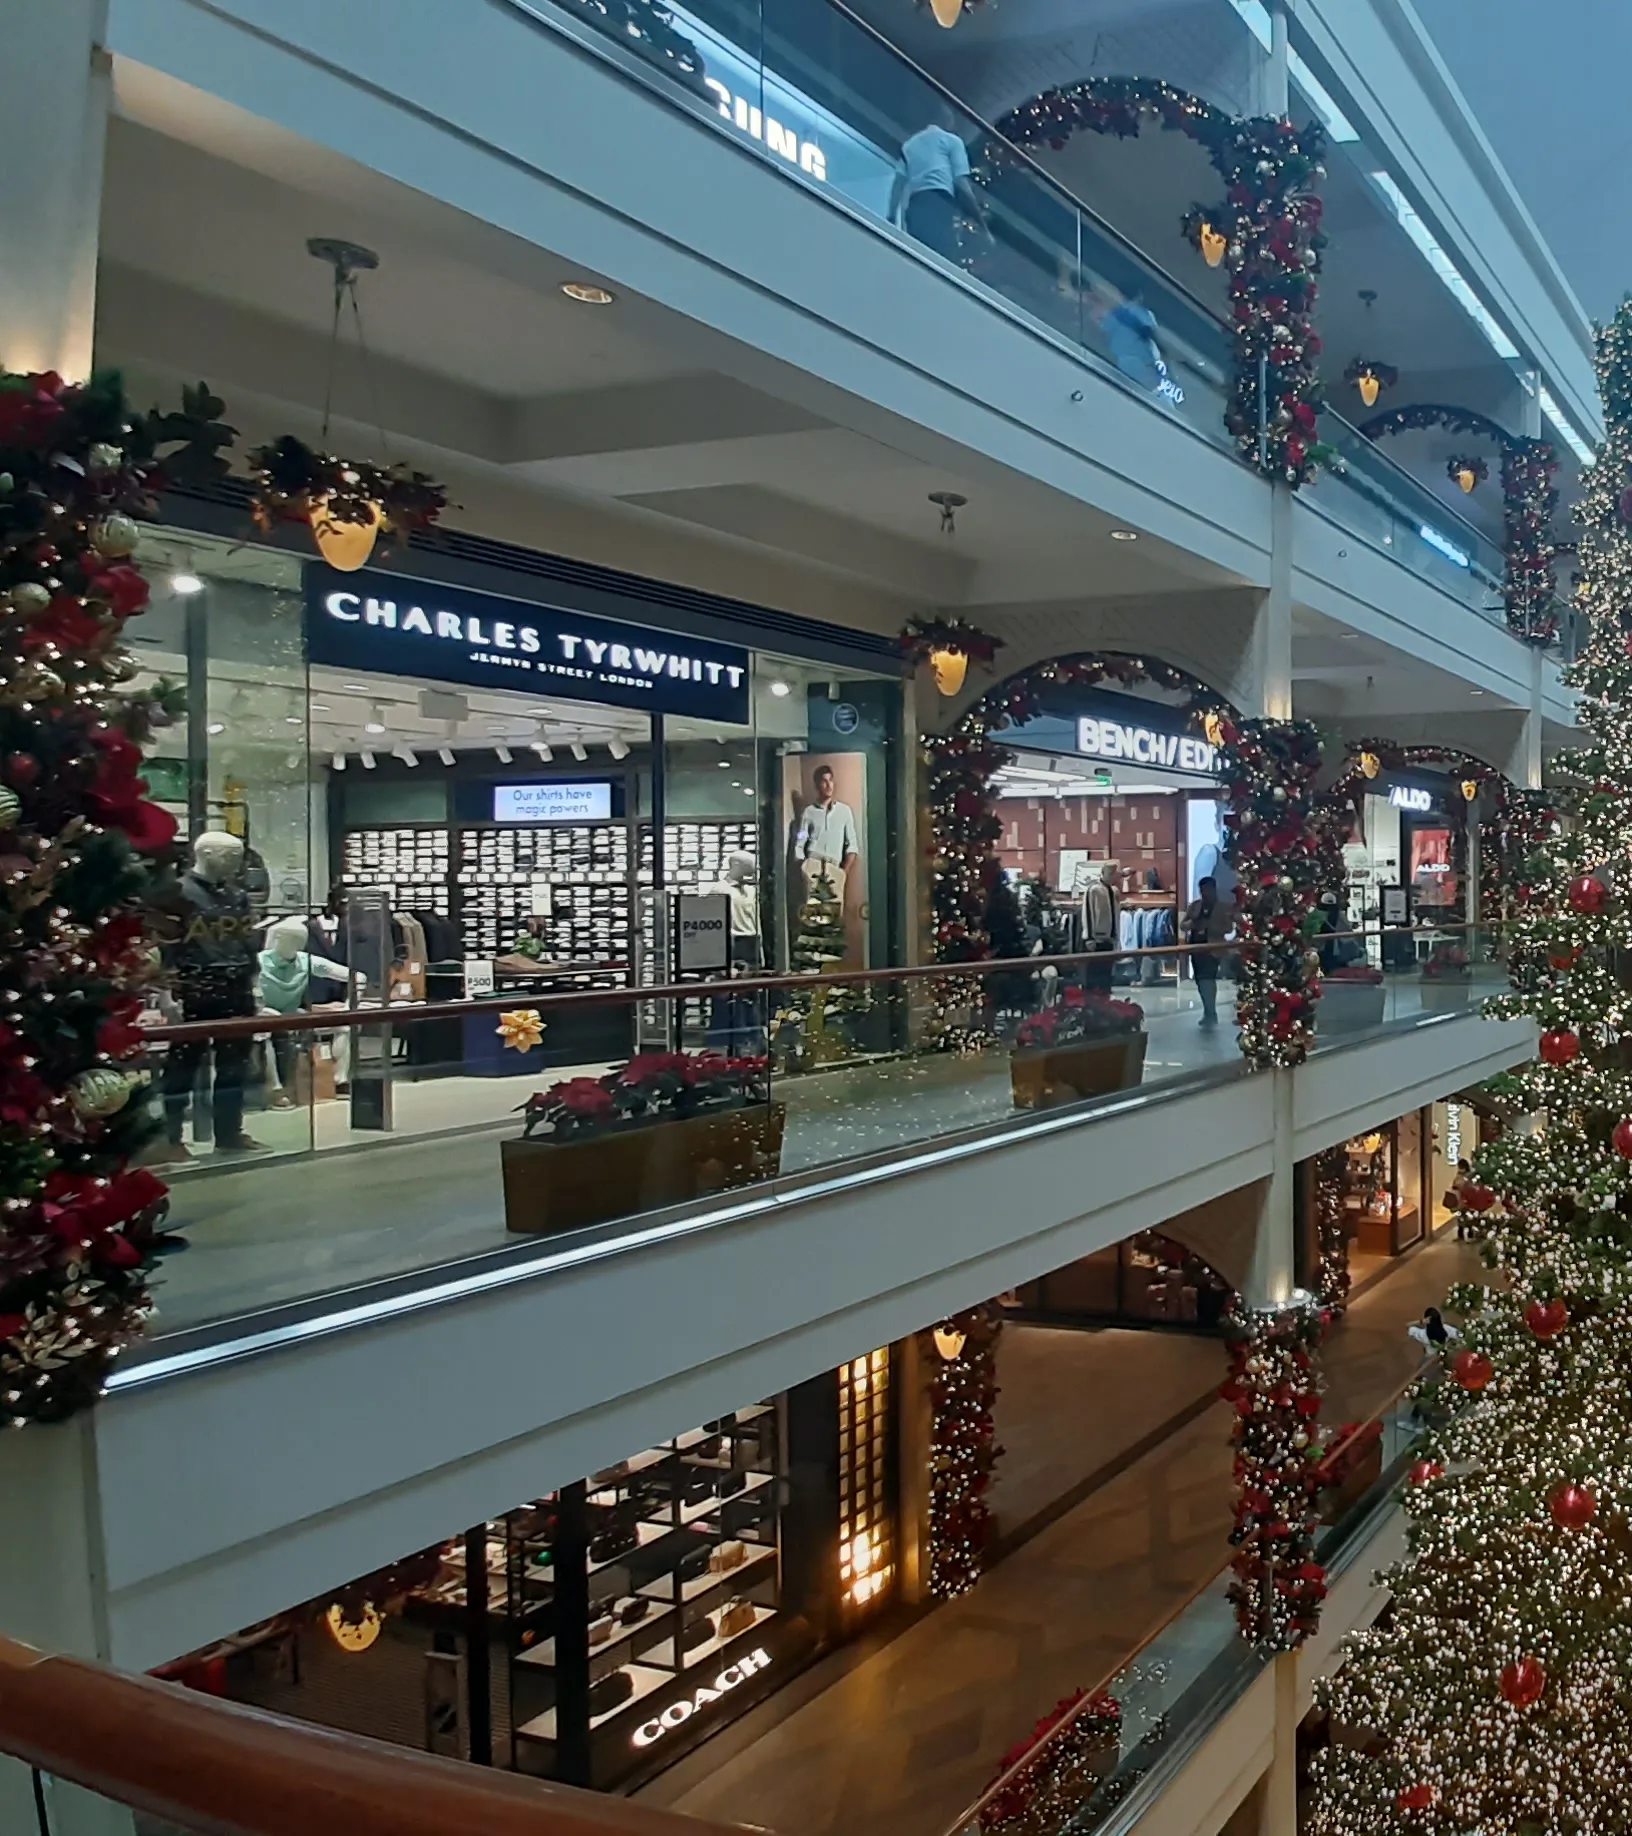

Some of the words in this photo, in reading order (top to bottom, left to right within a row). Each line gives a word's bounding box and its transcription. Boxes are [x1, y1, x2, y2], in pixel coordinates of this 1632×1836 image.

[324, 592, 540, 653] CHARLES
[558, 633, 745, 688] TYRWHITT
[537, 662, 595, 680] STREET
[600, 673, 653, 689] LONDON
[513, 789, 532, 801] Our
[536, 788, 563, 801] shirts
[565, 787, 593, 800] have
[1390, 786, 1432, 811] ALDO
[515, 803, 546, 817] magic
[549, 803, 589, 816] powers
[1446, 1132, 1461, 1166] Klein
[632, 1647, 773, 1747] COACH
